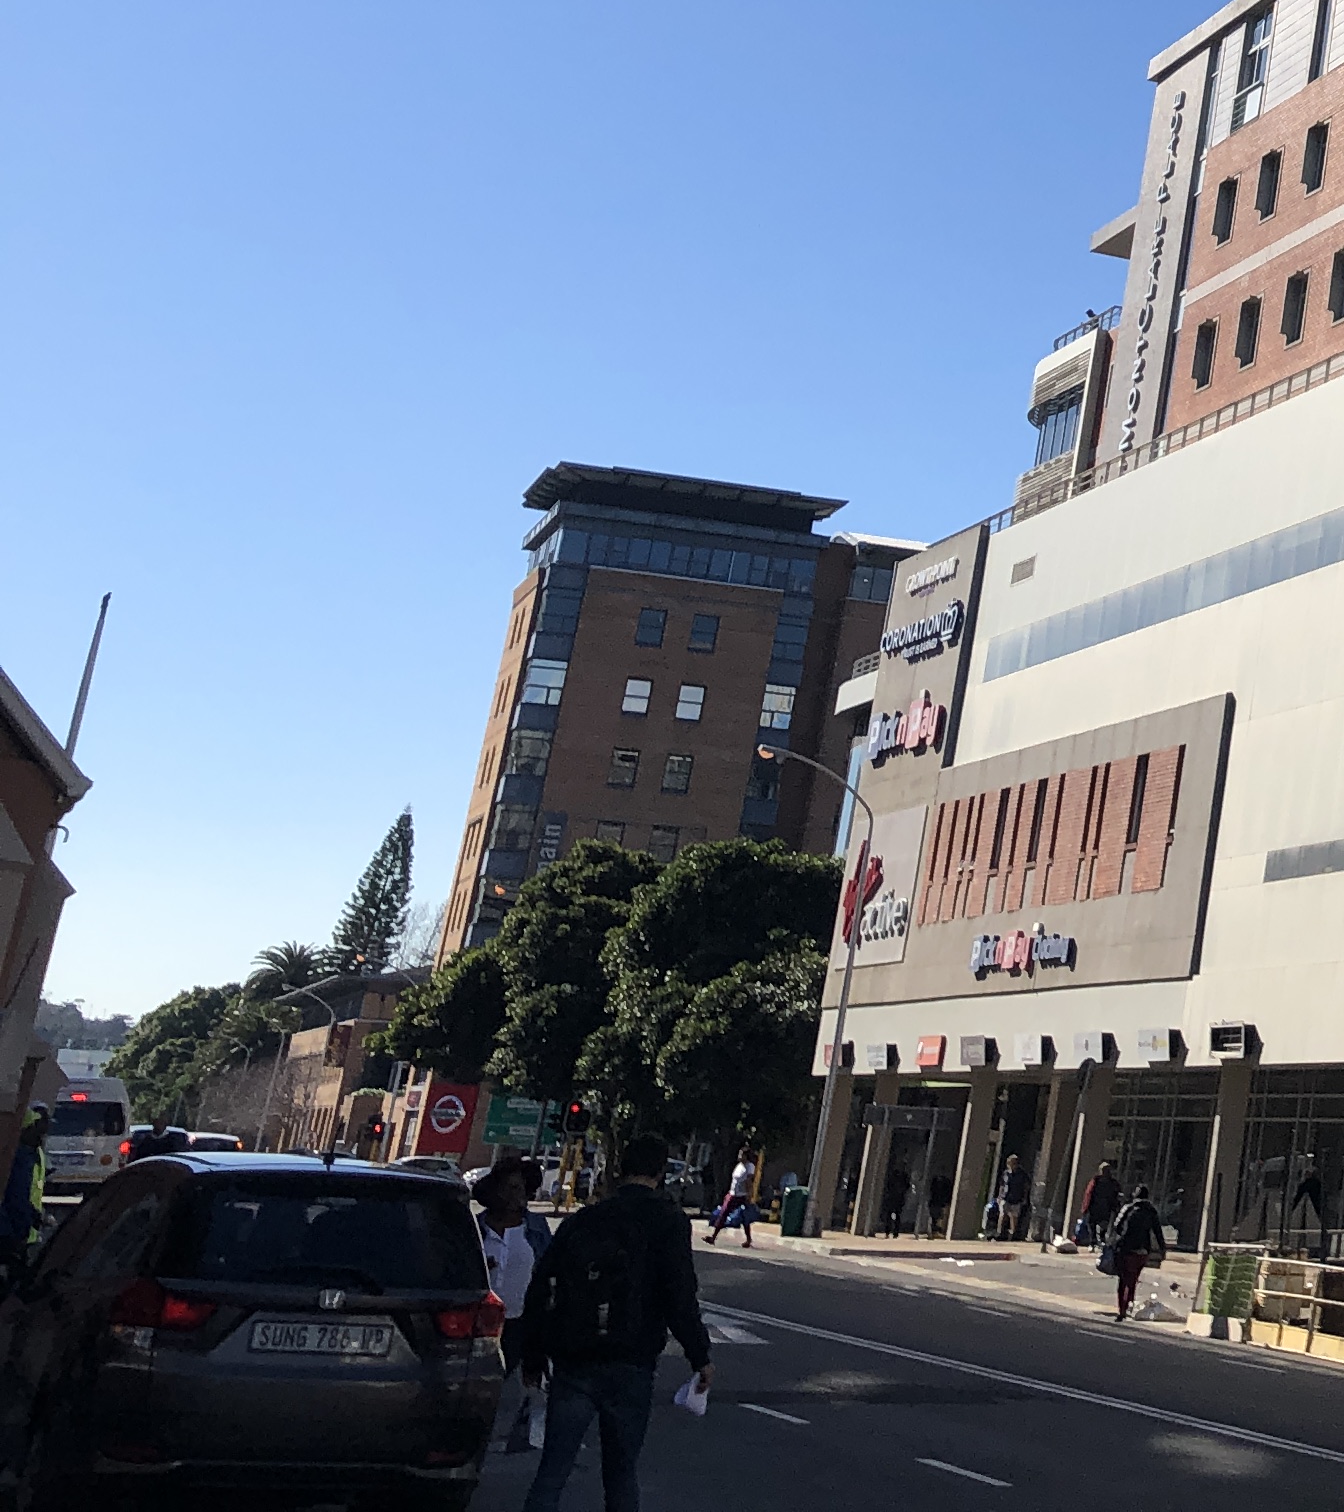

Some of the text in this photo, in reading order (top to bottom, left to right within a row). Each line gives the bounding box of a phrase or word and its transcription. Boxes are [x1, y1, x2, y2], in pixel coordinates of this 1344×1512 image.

[1156, 90, 1185, 204] PLACE
[880, 611, 943, 653] CORONATION
[867, 711, 899, 756] Pick
[905, 700, 940, 749] Pay
